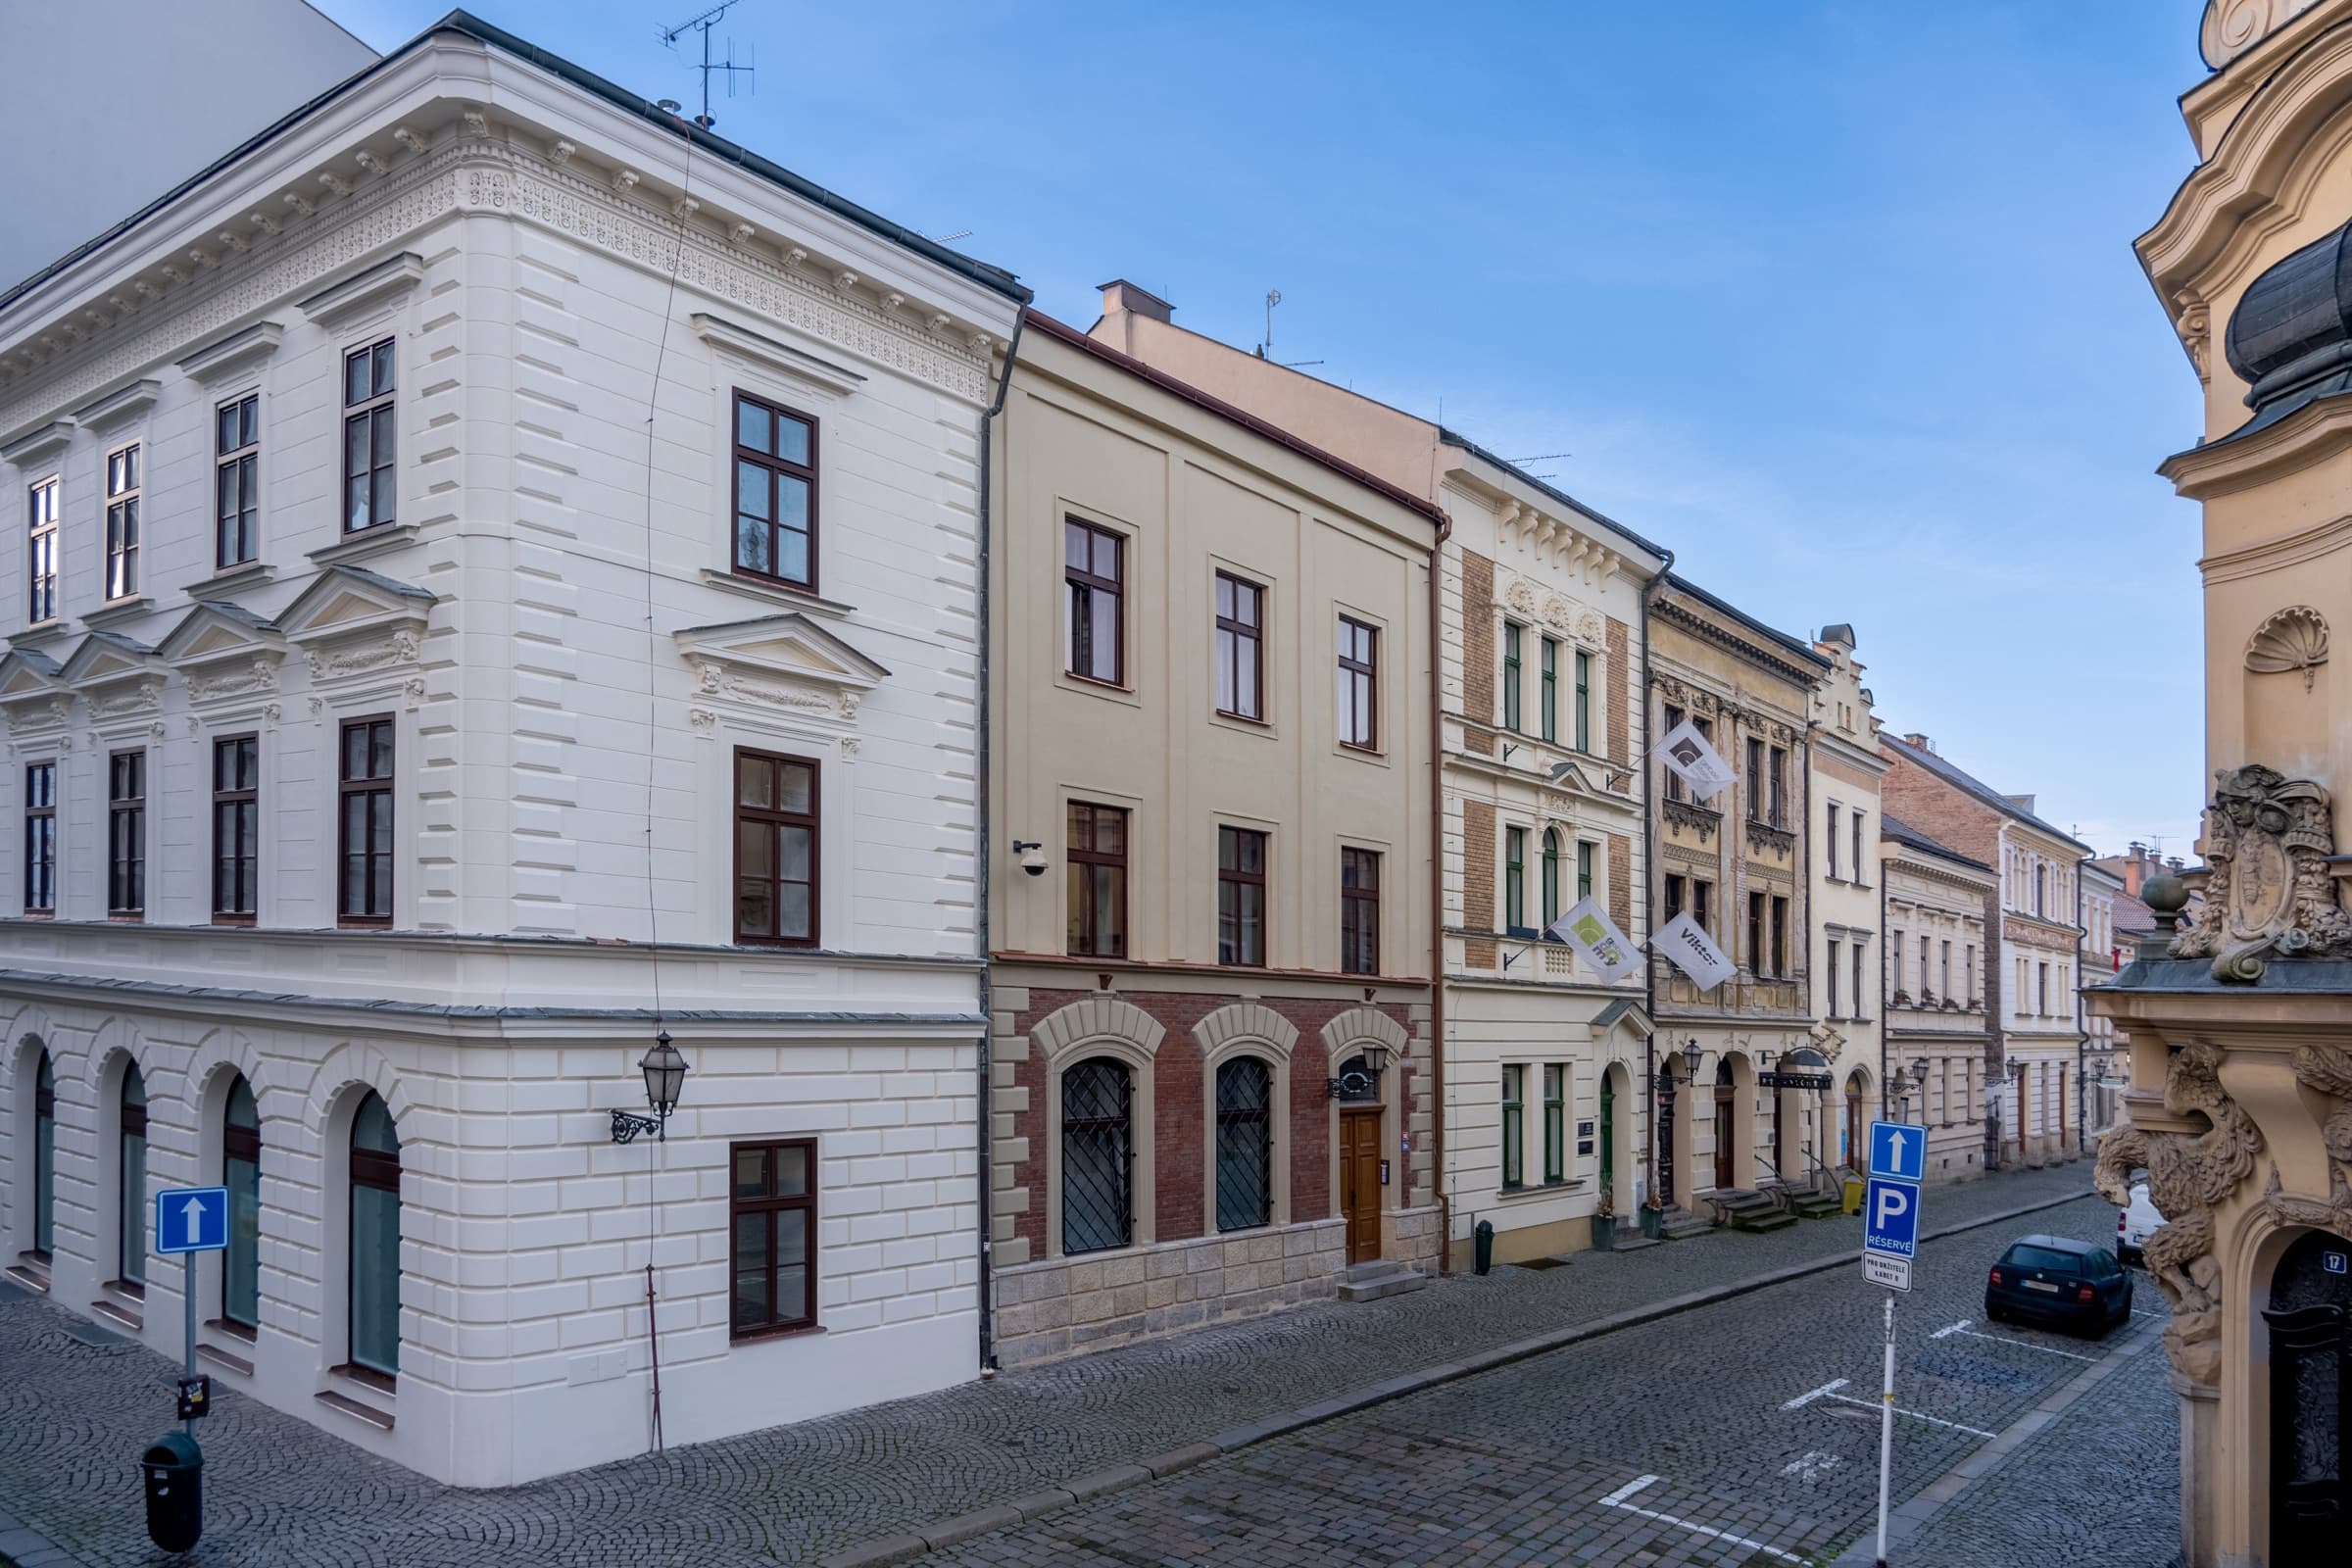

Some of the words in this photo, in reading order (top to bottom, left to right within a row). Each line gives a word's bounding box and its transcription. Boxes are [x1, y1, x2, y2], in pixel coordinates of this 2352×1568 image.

[1876, 1187, 1908, 1230] P
[1868, 1235, 1912, 1252] RÉSERVÉ
[2328, 1255, 2339, 1269] 17
